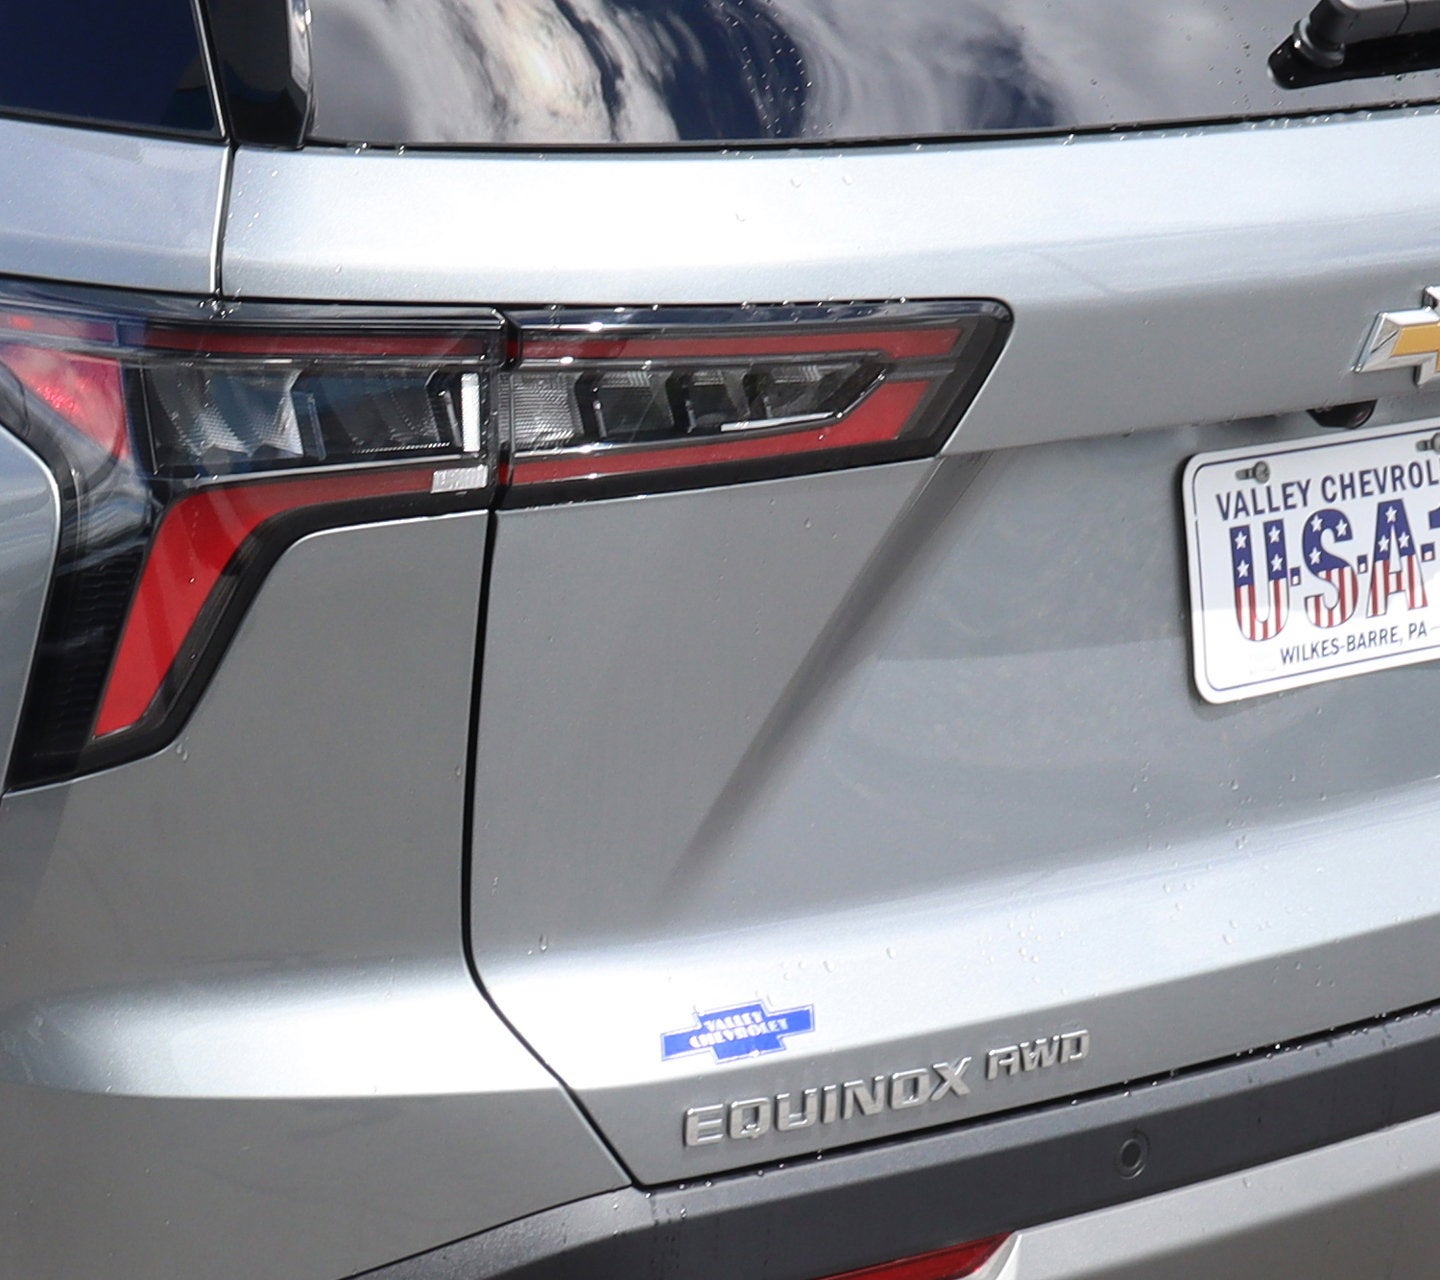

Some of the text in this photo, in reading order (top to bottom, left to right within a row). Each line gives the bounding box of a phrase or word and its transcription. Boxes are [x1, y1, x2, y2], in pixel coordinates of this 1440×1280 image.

[1215, 477, 1311, 522] VALLEY
[1279, 620, 1428, 667] WILKES-BARRE, PA
[688, 1017, 789, 1049] CHEVROLET
[703, 1010, 764, 1033] VALLEY
[683, 1028, 1090, 1147] EQUINOX AWD
